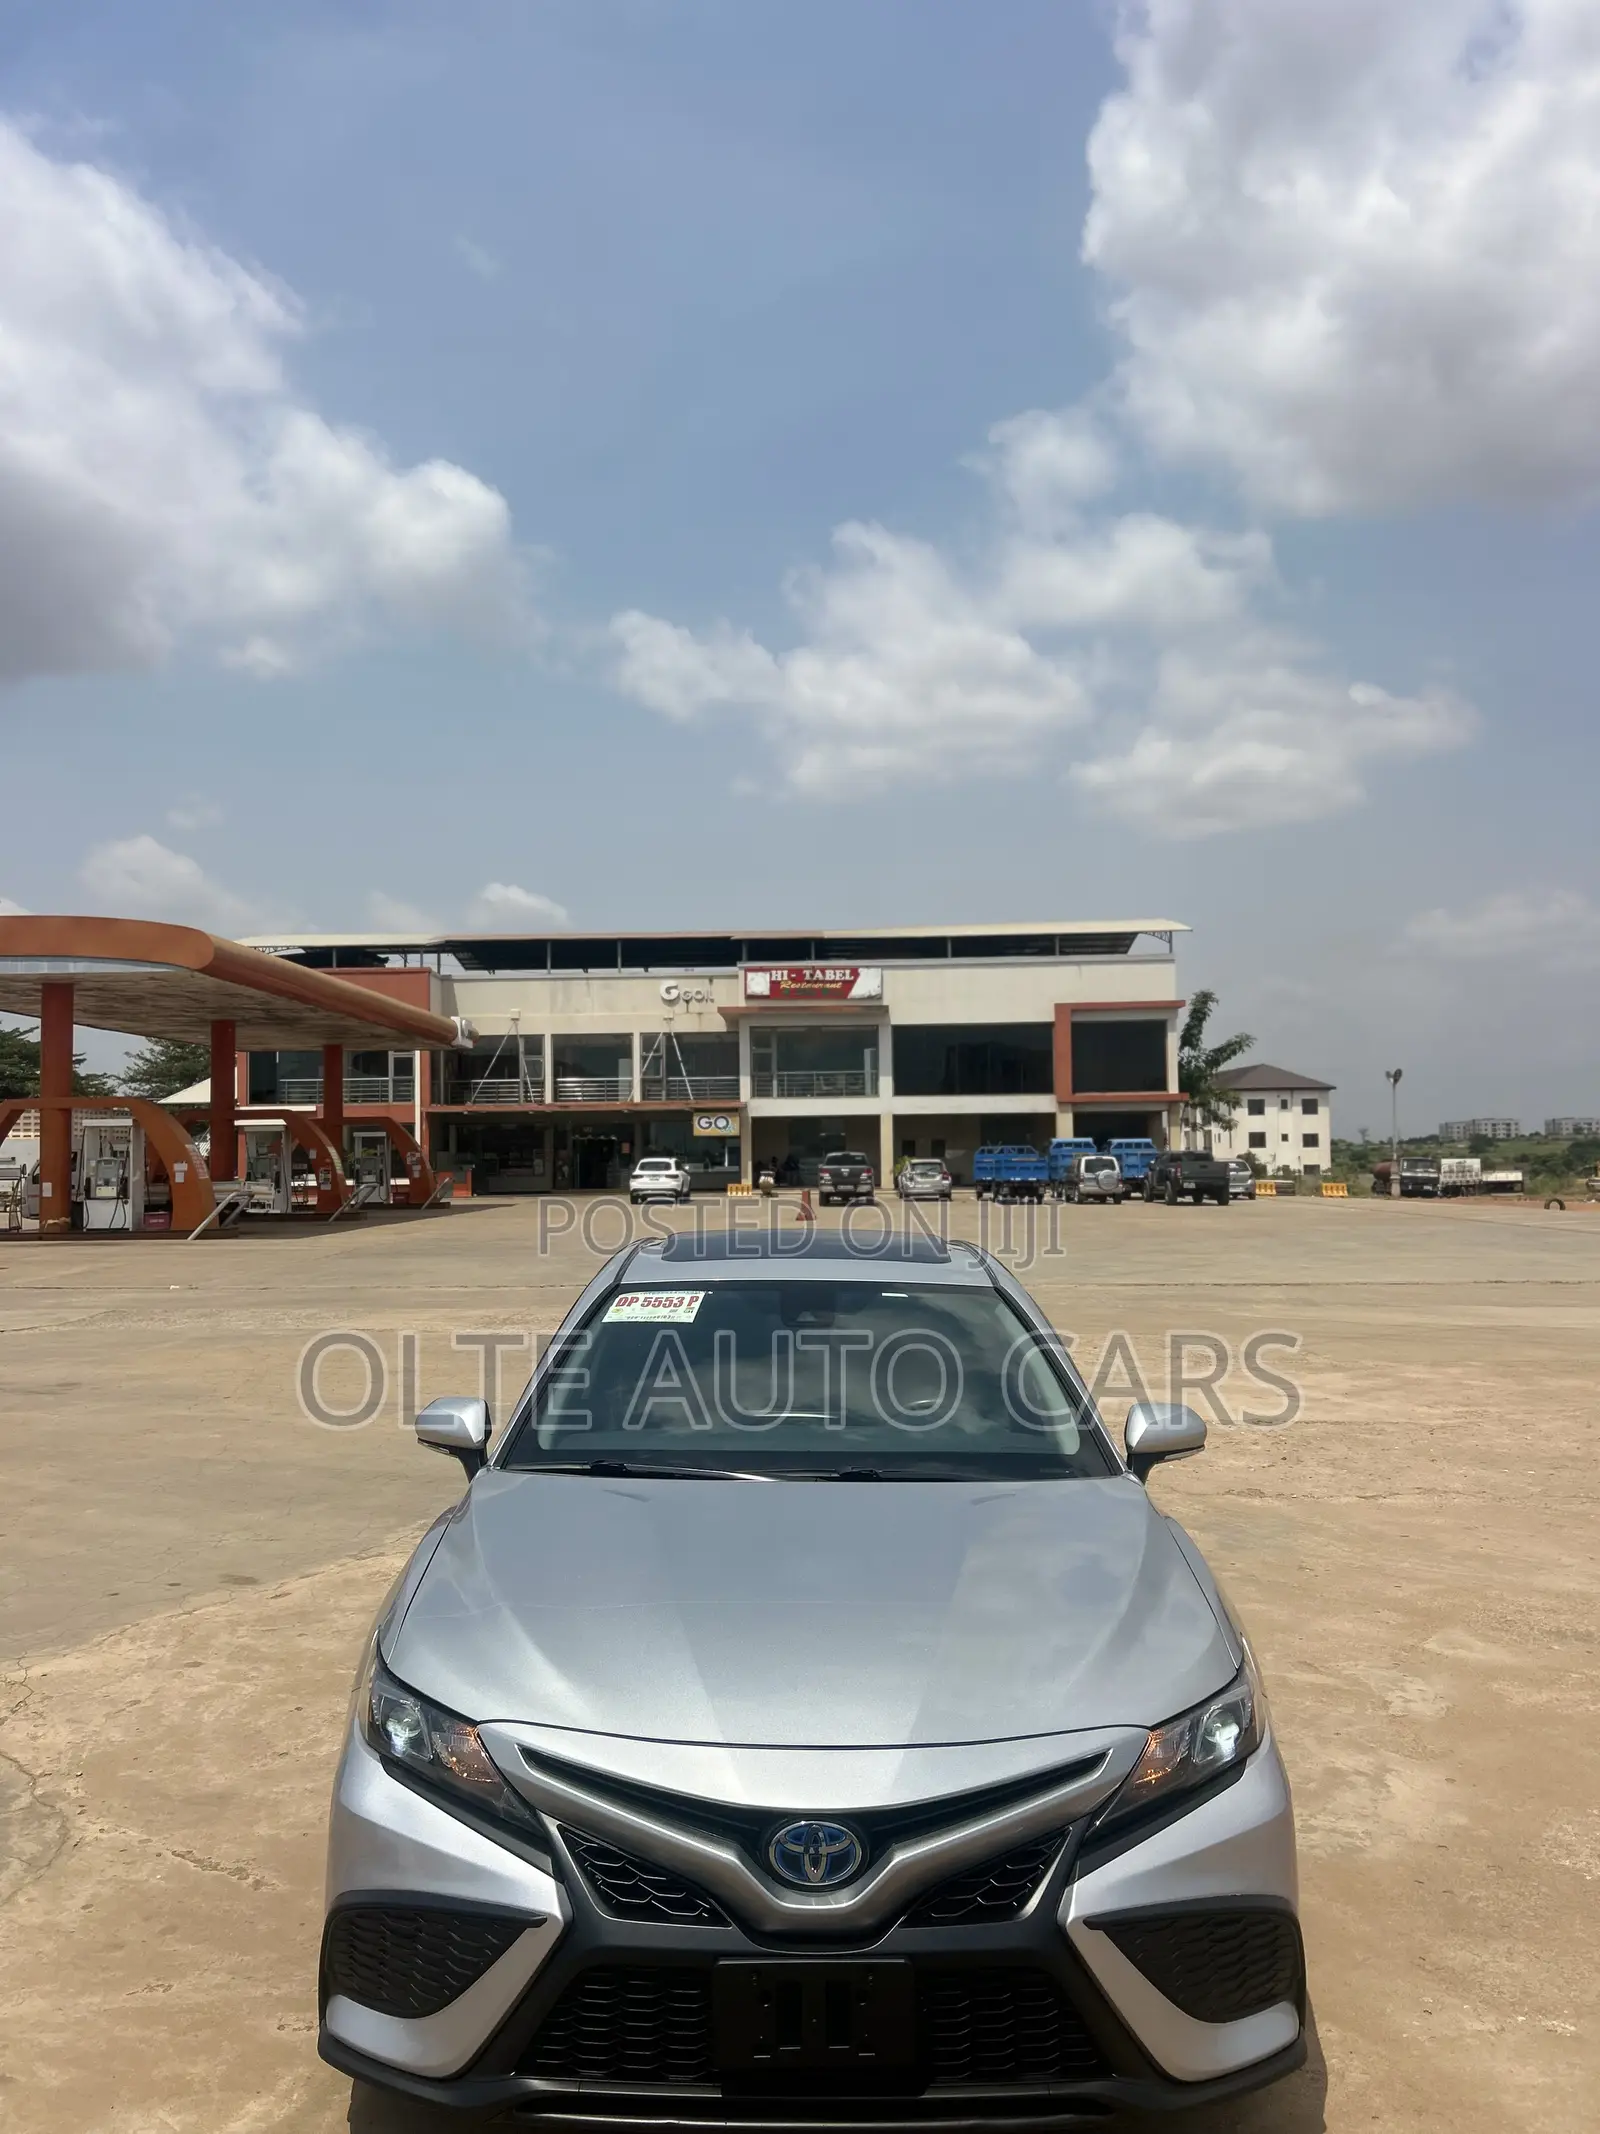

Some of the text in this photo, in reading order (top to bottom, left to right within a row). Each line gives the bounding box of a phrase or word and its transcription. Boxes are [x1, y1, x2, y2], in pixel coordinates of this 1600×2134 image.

[803, 969, 854, 980] TABEL
[615, 1295, 700, 1308] DP 5553 P
